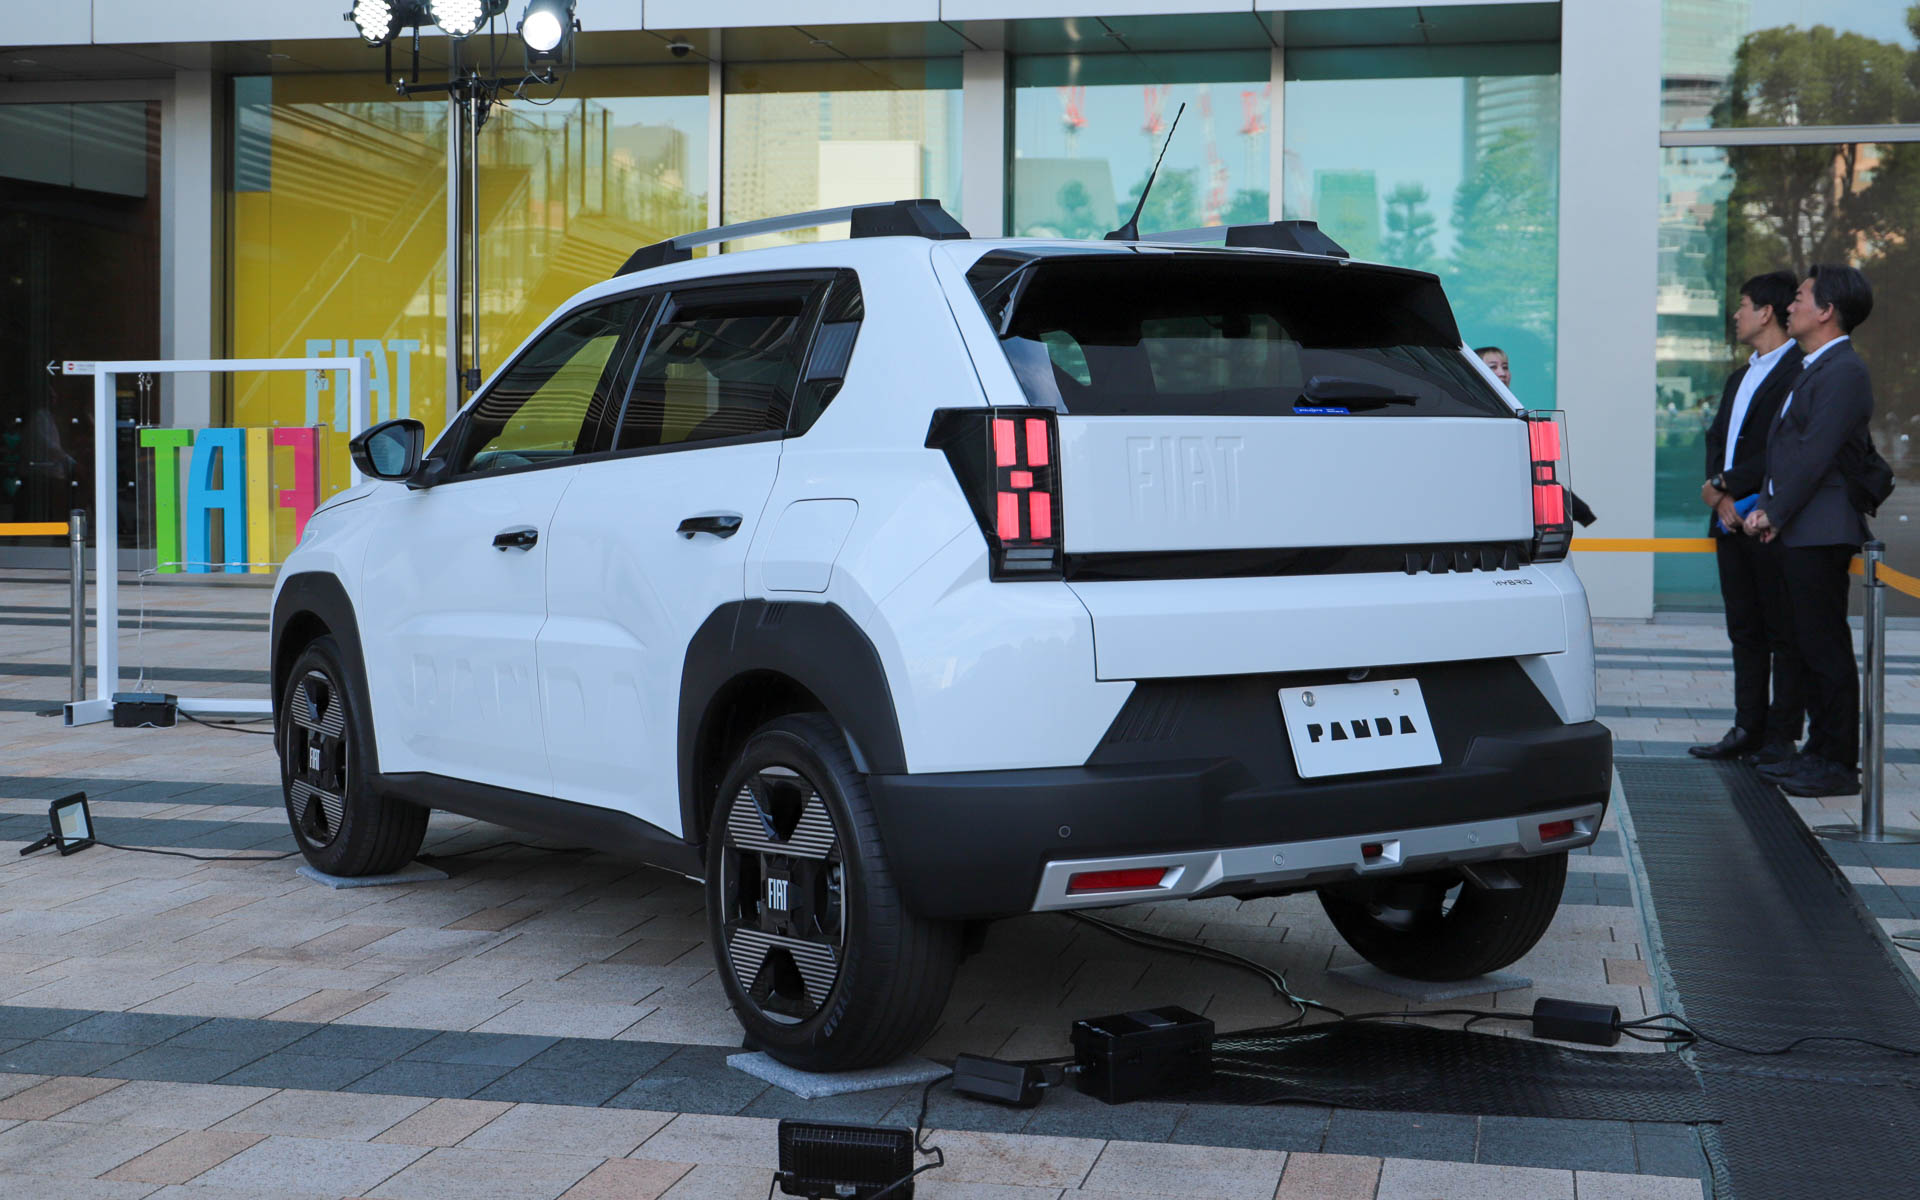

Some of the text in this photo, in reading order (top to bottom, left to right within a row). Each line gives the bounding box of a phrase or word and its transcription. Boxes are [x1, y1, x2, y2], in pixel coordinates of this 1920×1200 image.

[304, 339, 420, 432] FIAT
[1126, 435, 1243, 522] FIAT
[1307, 715, 1417, 743] PANDA
[768, 878, 788, 911] FIAT
[823, 948, 857, 1038] ODYEAR
